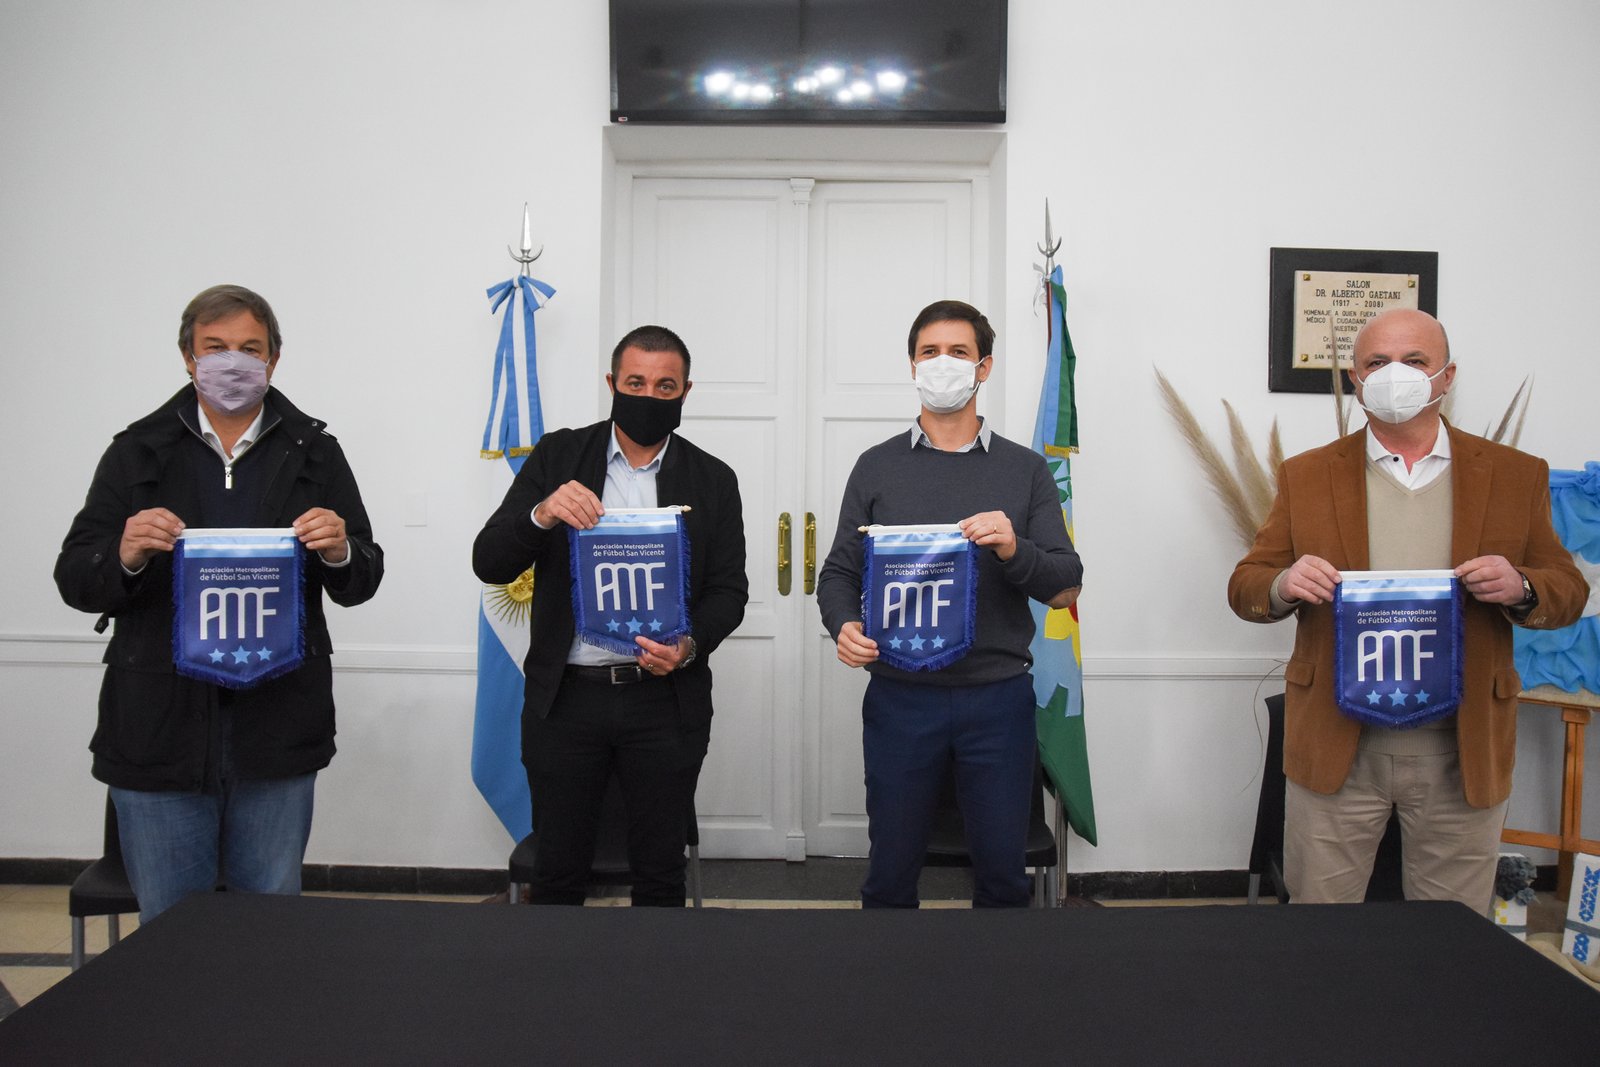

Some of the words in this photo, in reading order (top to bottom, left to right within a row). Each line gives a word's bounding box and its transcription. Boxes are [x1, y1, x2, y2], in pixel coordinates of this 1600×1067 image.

[1346, 280, 1371, 289] SALON
[1331, 289, 1365, 299] ALBERTO
[1368, 290, 1401, 300] GAETANI
[1332, 299, 1350, 307] (1917
[1364, 300, 1384, 308] 2008)
[1306, 316, 1326, 324] MÉDICO
[1336, 317, 1367, 325] CIUDADANO
[1325, 343, 1354, 351] INTNDENT
[915, 561, 954, 569] Metropolitana
[235, 566, 280, 574] Metropolitana
[894, 568, 916, 576] Fútbol
[916, 568, 929, 576] San
[211, 573, 236, 581] Fútbol
[237, 573, 251, 581] San
[594, 561, 666, 611] AMF
[882, 578, 954, 629] AMF
[200, 586, 280, 641] AMF
[1357, 617, 1367, 625] de
[1368, 616, 1392, 624] Fútbol
[1393, 615, 1408, 623] San
[1408, 615, 1438, 623] Vicente
[1357, 628, 1437, 682] AMF
